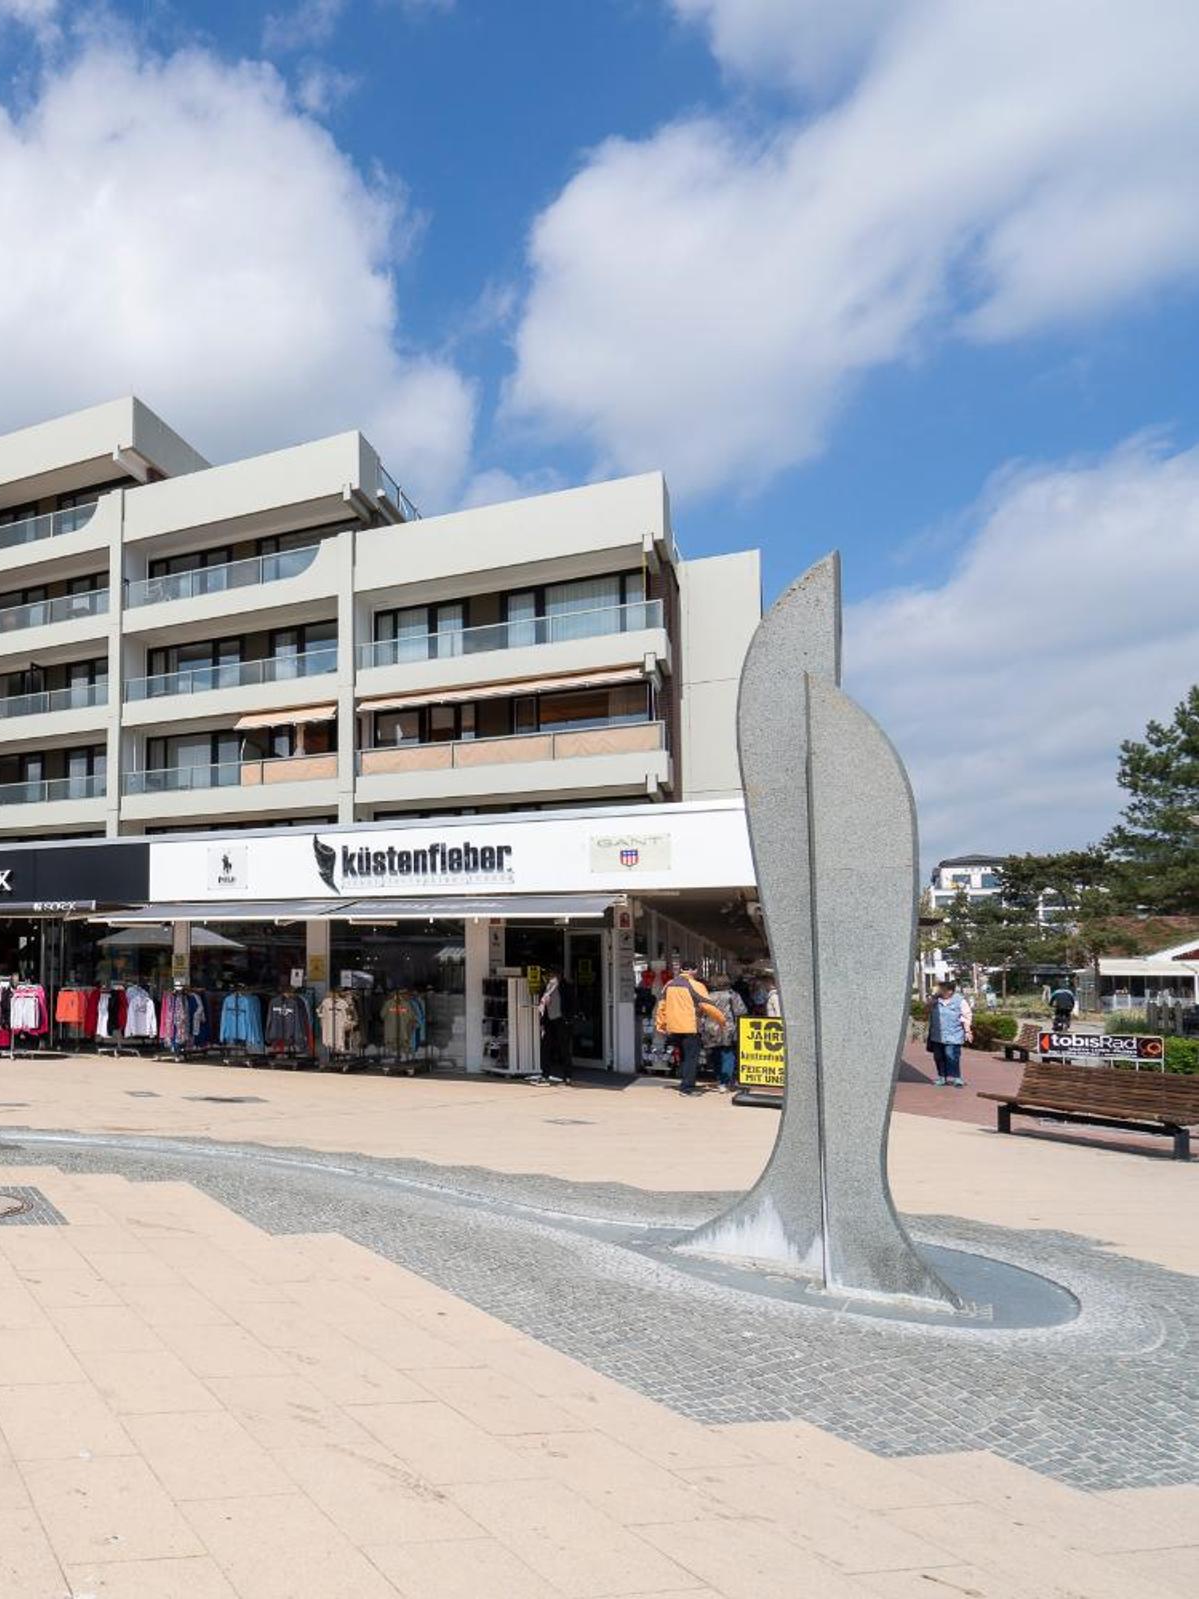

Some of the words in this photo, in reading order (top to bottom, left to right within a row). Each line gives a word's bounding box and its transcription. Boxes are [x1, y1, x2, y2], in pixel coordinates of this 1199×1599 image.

[597, 836, 664, 848] GANT
[341, 841, 513, 878] küstenfieber
[1050, 1034, 1137, 1050] tobisRad
[741, 1064, 776, 1075] FEIERN
[746, 1074, 762, 1082] MIT
